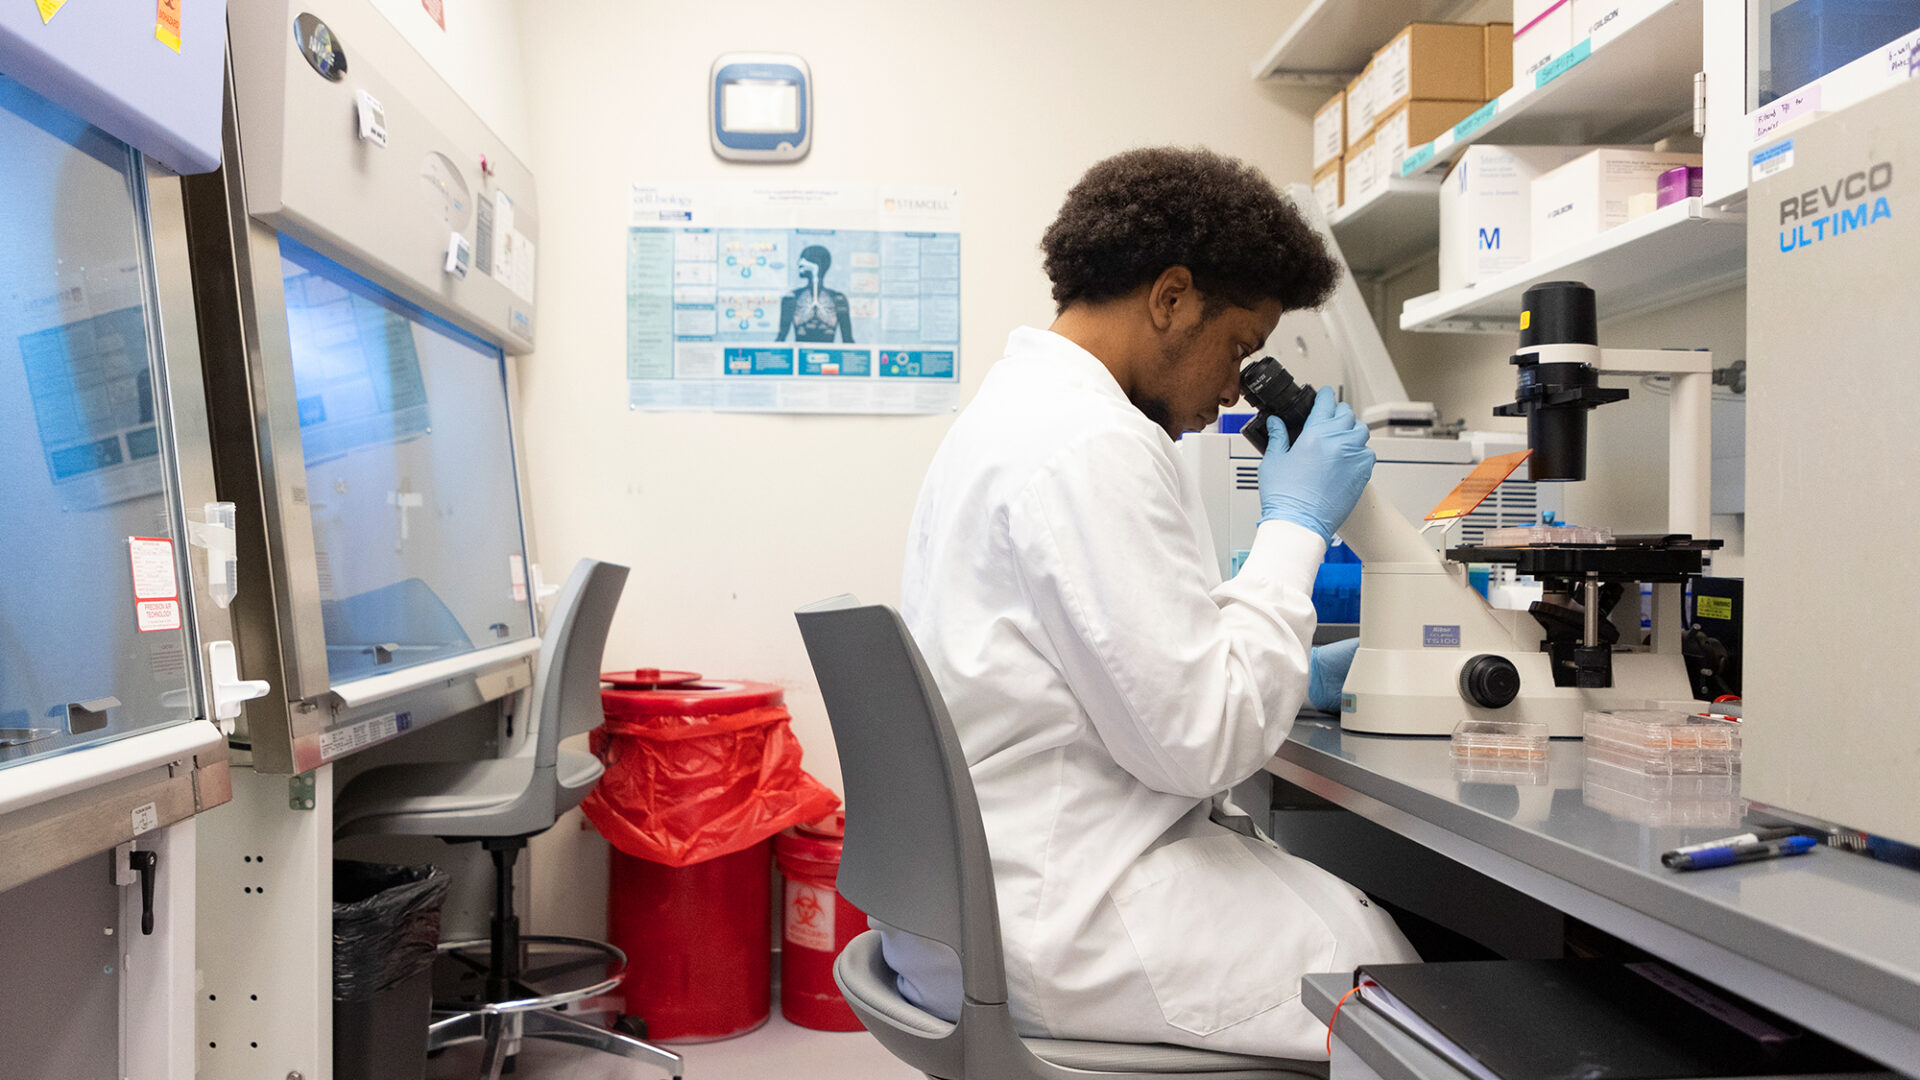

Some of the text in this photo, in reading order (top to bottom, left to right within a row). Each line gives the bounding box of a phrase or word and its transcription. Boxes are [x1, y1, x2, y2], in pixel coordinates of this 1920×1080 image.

[1593, 8, 1619, 31] GILSON
[1780, 161, 1892, 225] REVCO
[897, 199, 950, 211] STEMCELL
[1780, 196, 1892, 253] ULTIMA
[1479, 227, 1500, 250] M
